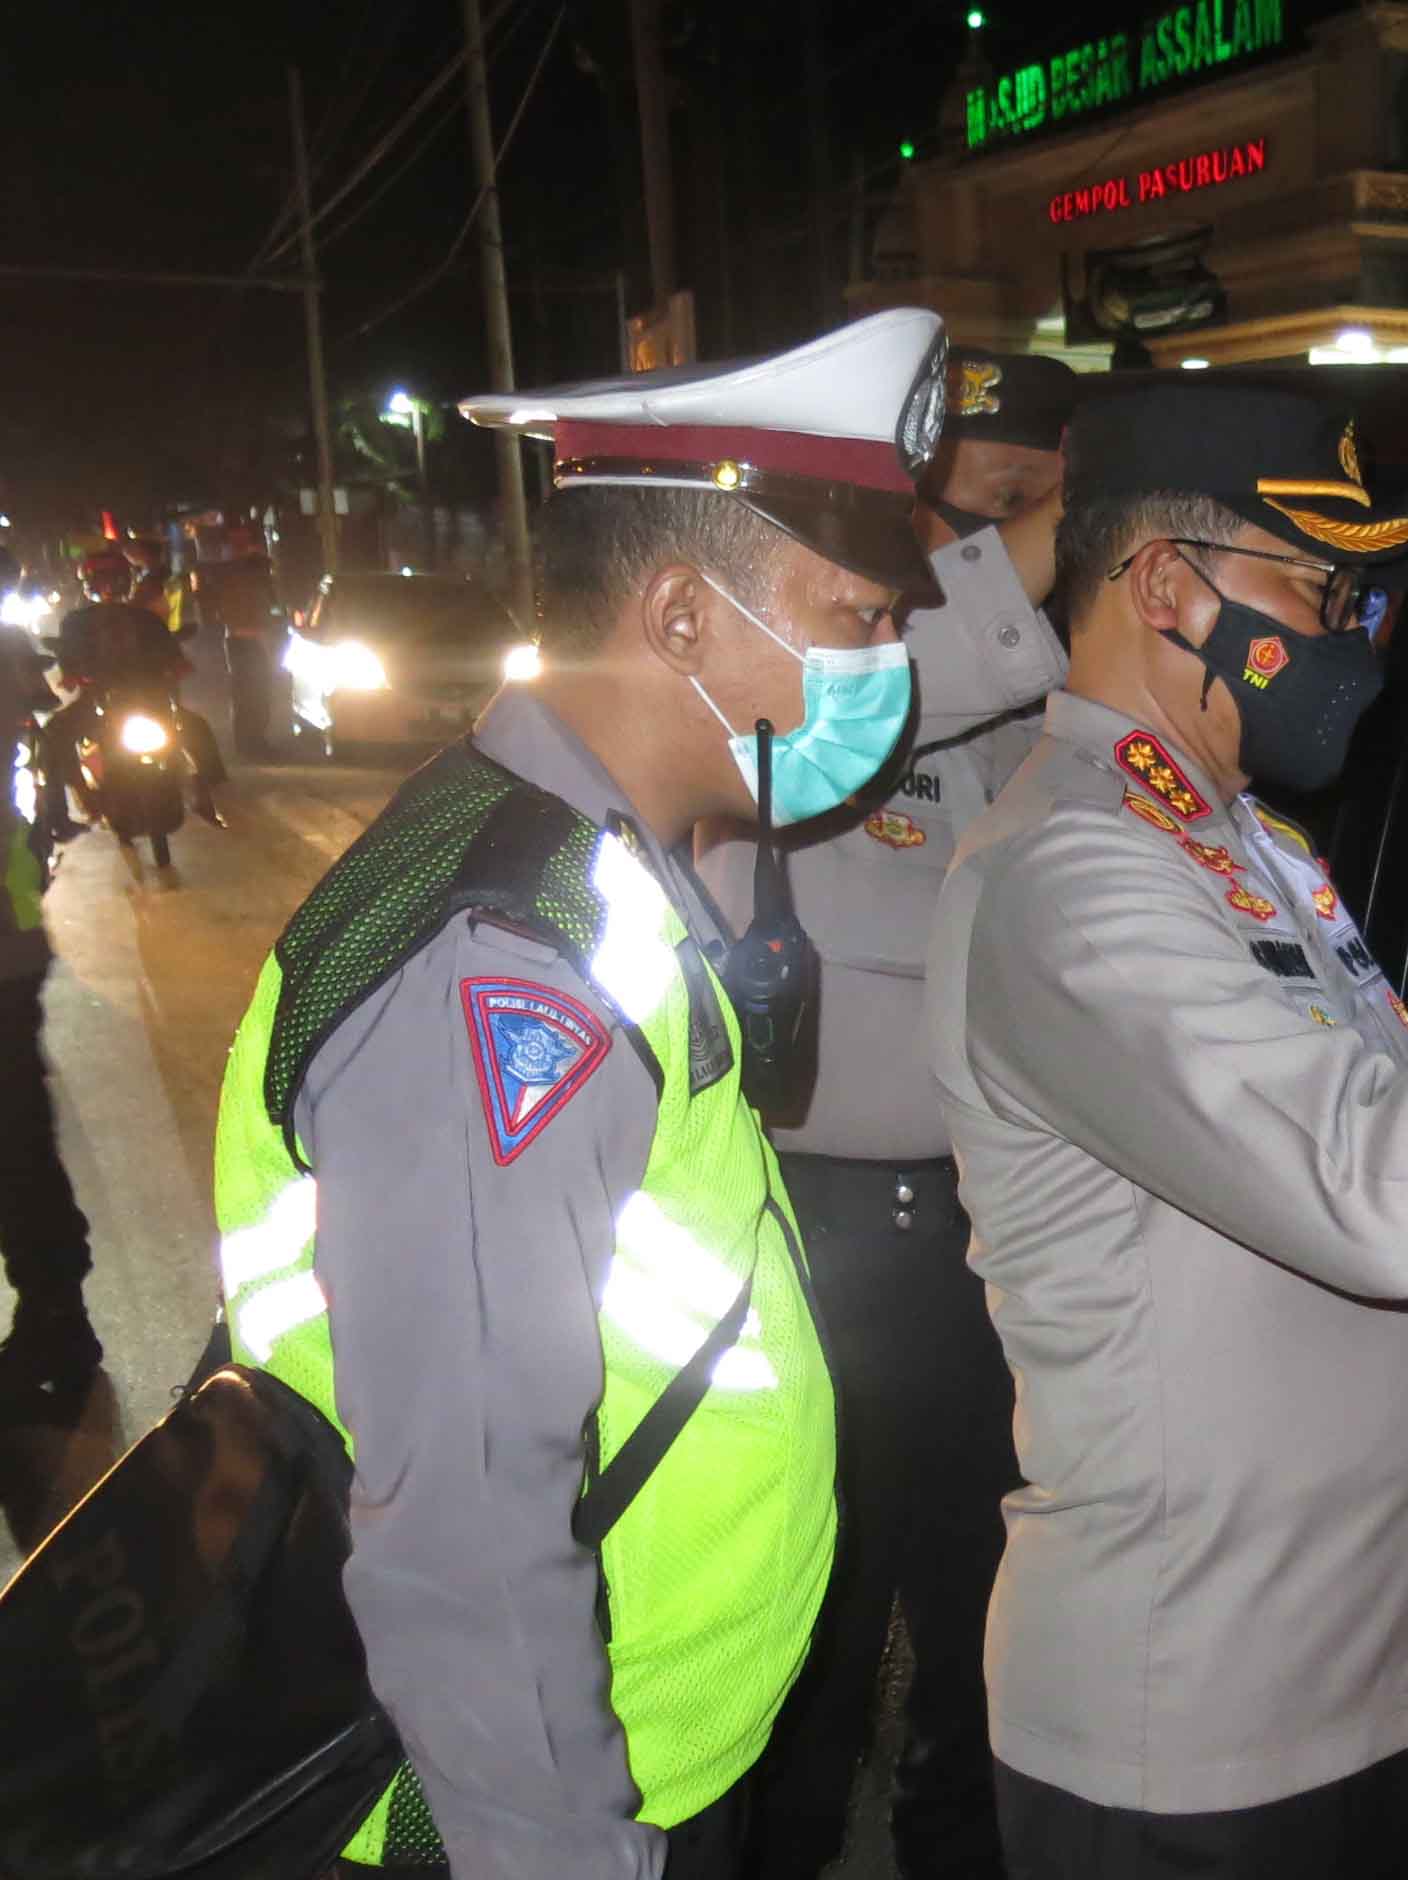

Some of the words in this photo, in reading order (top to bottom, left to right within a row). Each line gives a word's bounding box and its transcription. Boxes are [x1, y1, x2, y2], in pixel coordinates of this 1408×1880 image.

[1140, 0, 1284, 87] ASSALAM
[1049, 179, 1131, 224] GEMPOL
[1138, 139, 1265, 204] PASURUAN
[1242, 668, 1269, 689] TNI
